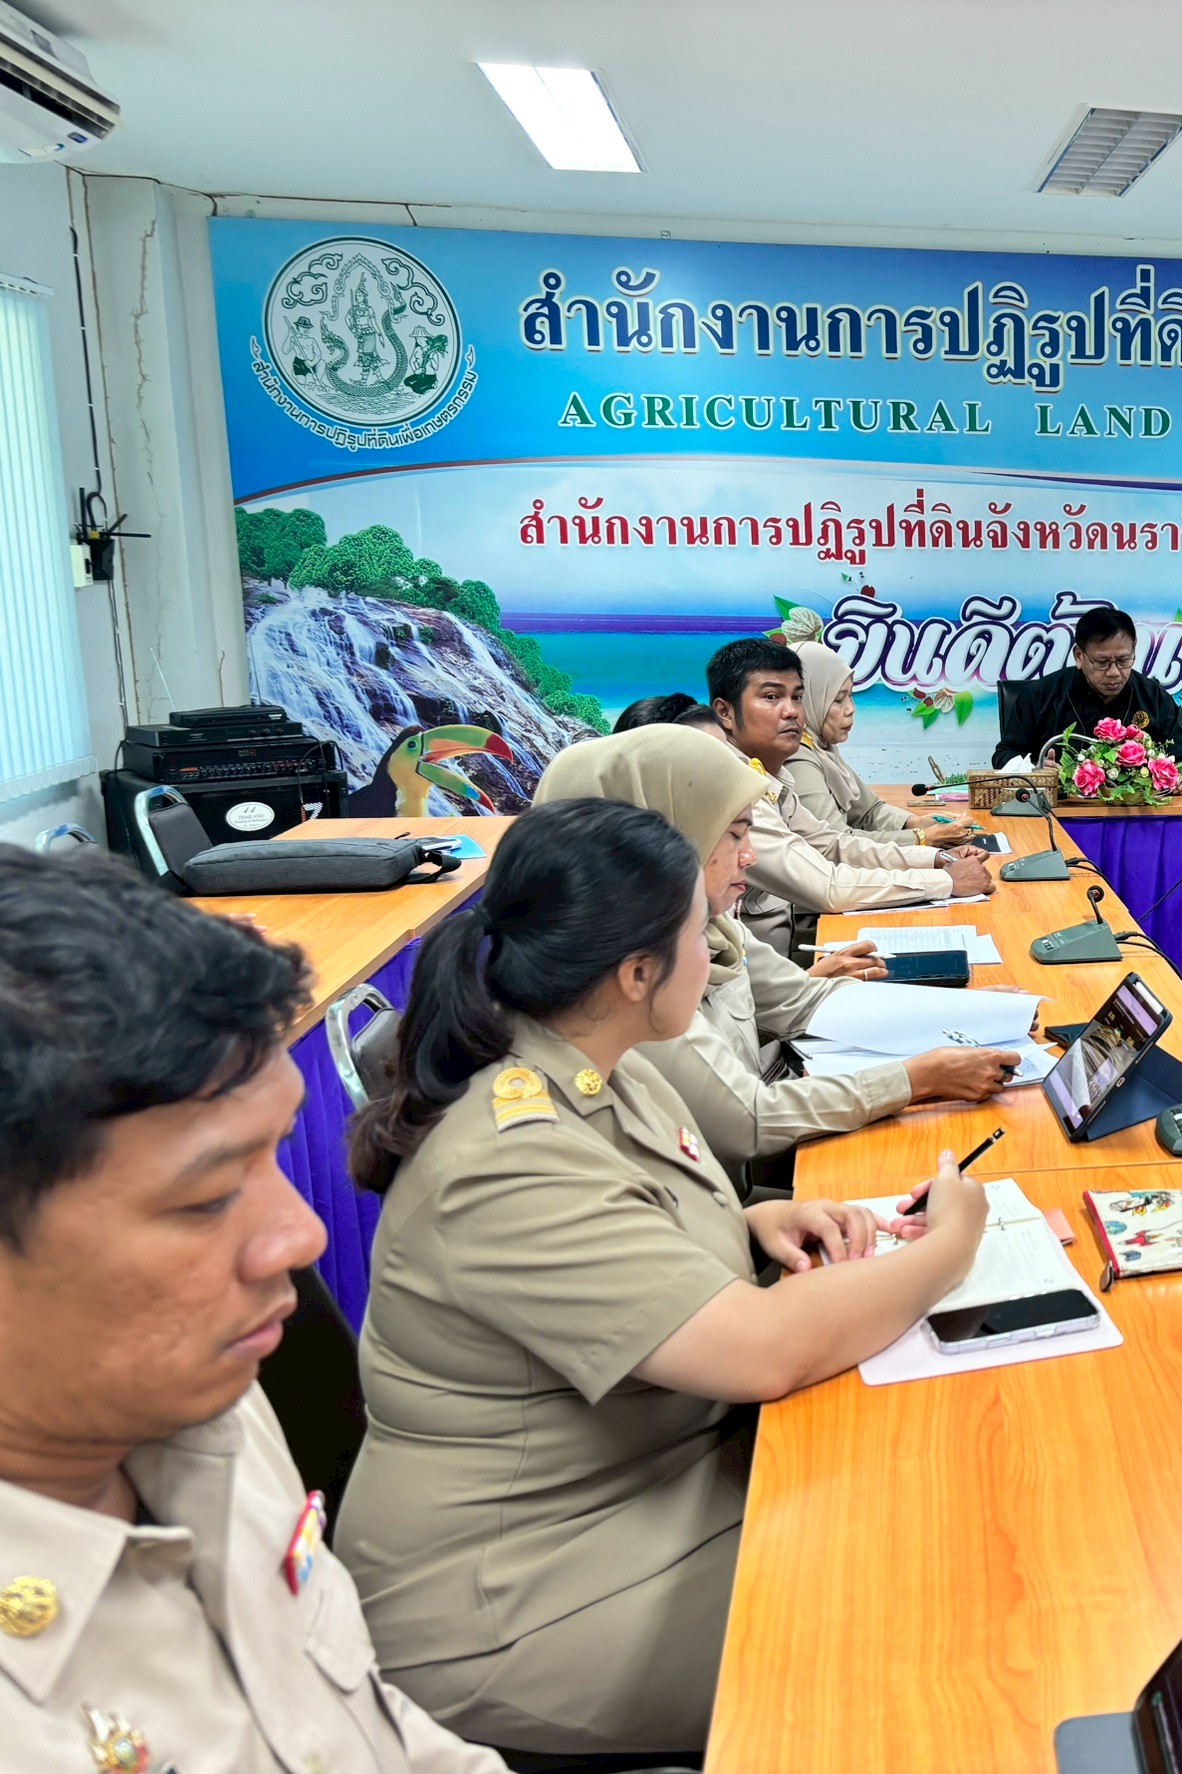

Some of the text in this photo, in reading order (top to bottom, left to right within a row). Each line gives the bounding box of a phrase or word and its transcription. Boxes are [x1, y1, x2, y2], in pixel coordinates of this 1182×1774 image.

[252, 361, 478, 450] สำนักงานการปฏิรูปที่ดินเพื่อเกษตรกรรม
[559, 391, 991, 435] AGRICULTURAL
[1037, 404, 1170, 440] LAND
